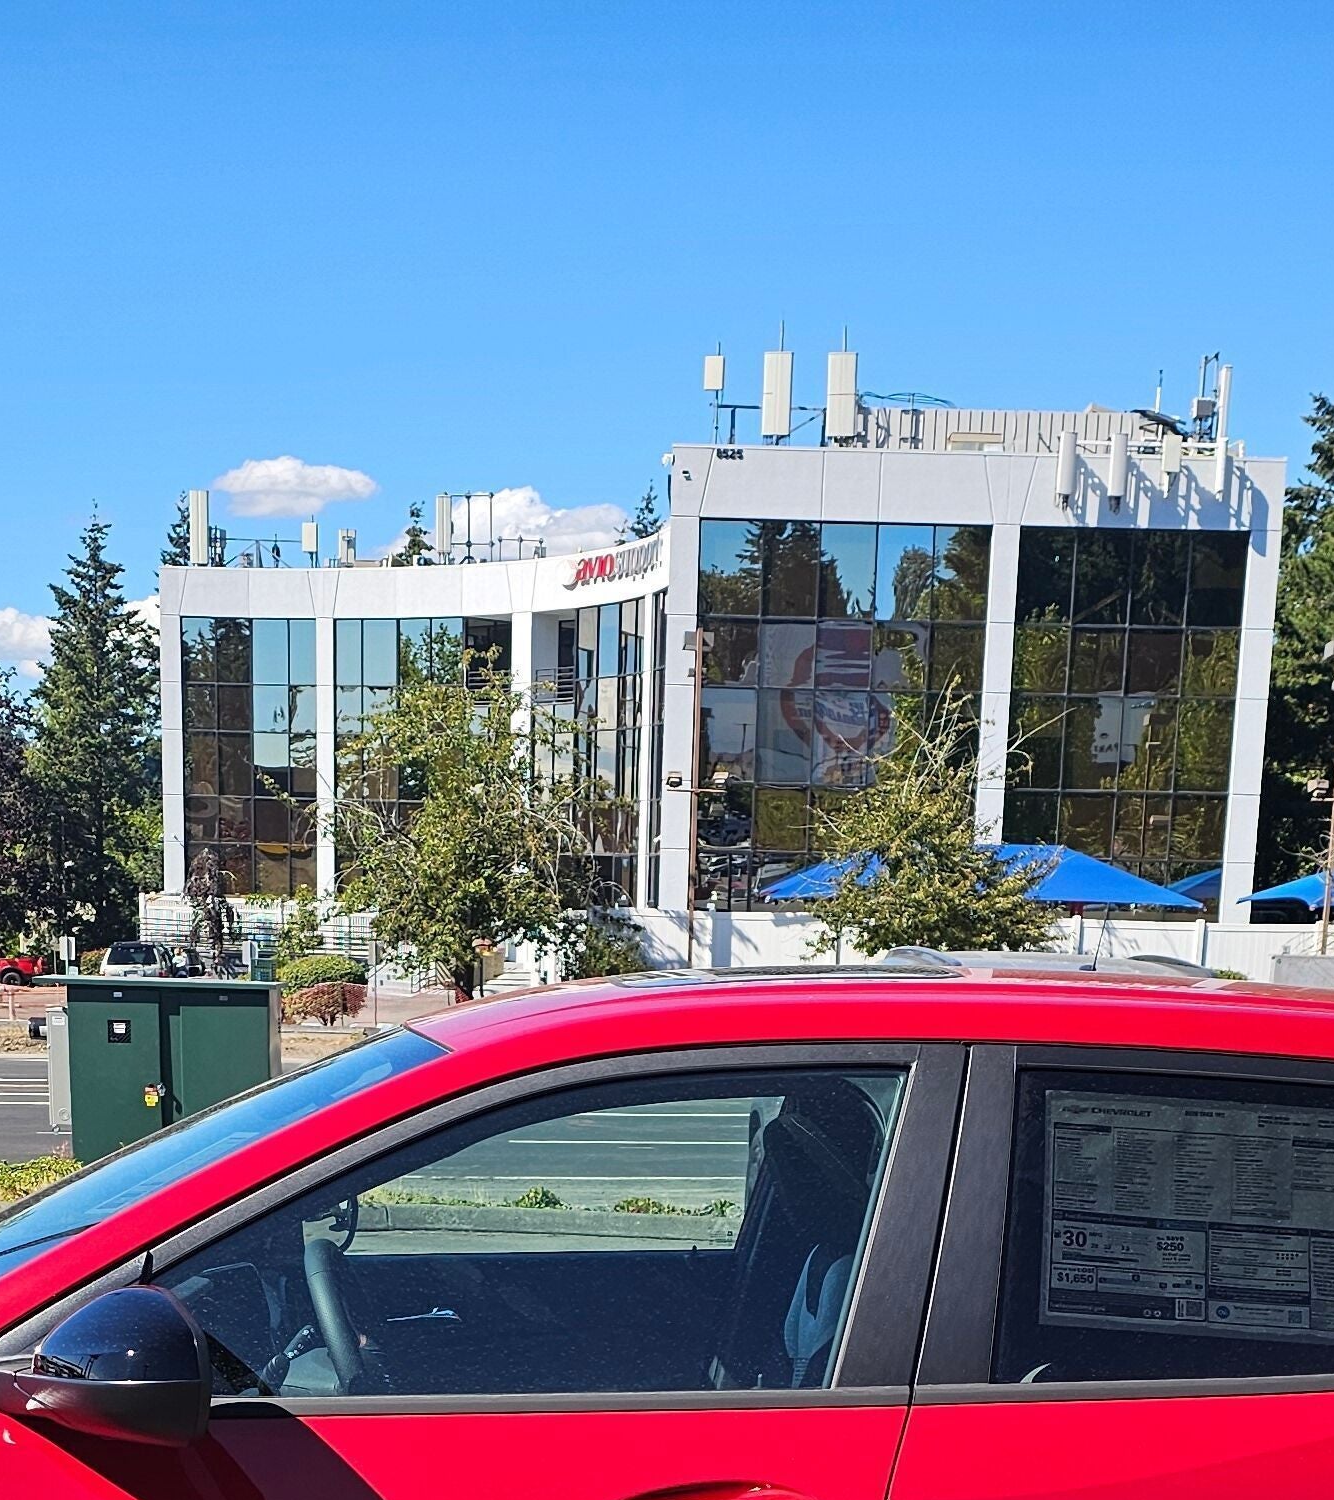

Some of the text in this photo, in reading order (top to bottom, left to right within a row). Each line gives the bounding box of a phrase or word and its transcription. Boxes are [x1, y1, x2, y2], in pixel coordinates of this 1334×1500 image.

[1090, 1106, 1152, 1118] CHEVROLET
[1062, 1229, 1087, 1248] 30
[1156, 1241, 1185, 1252] $250
[1056, 1271, 1093, 1284] $1,650
